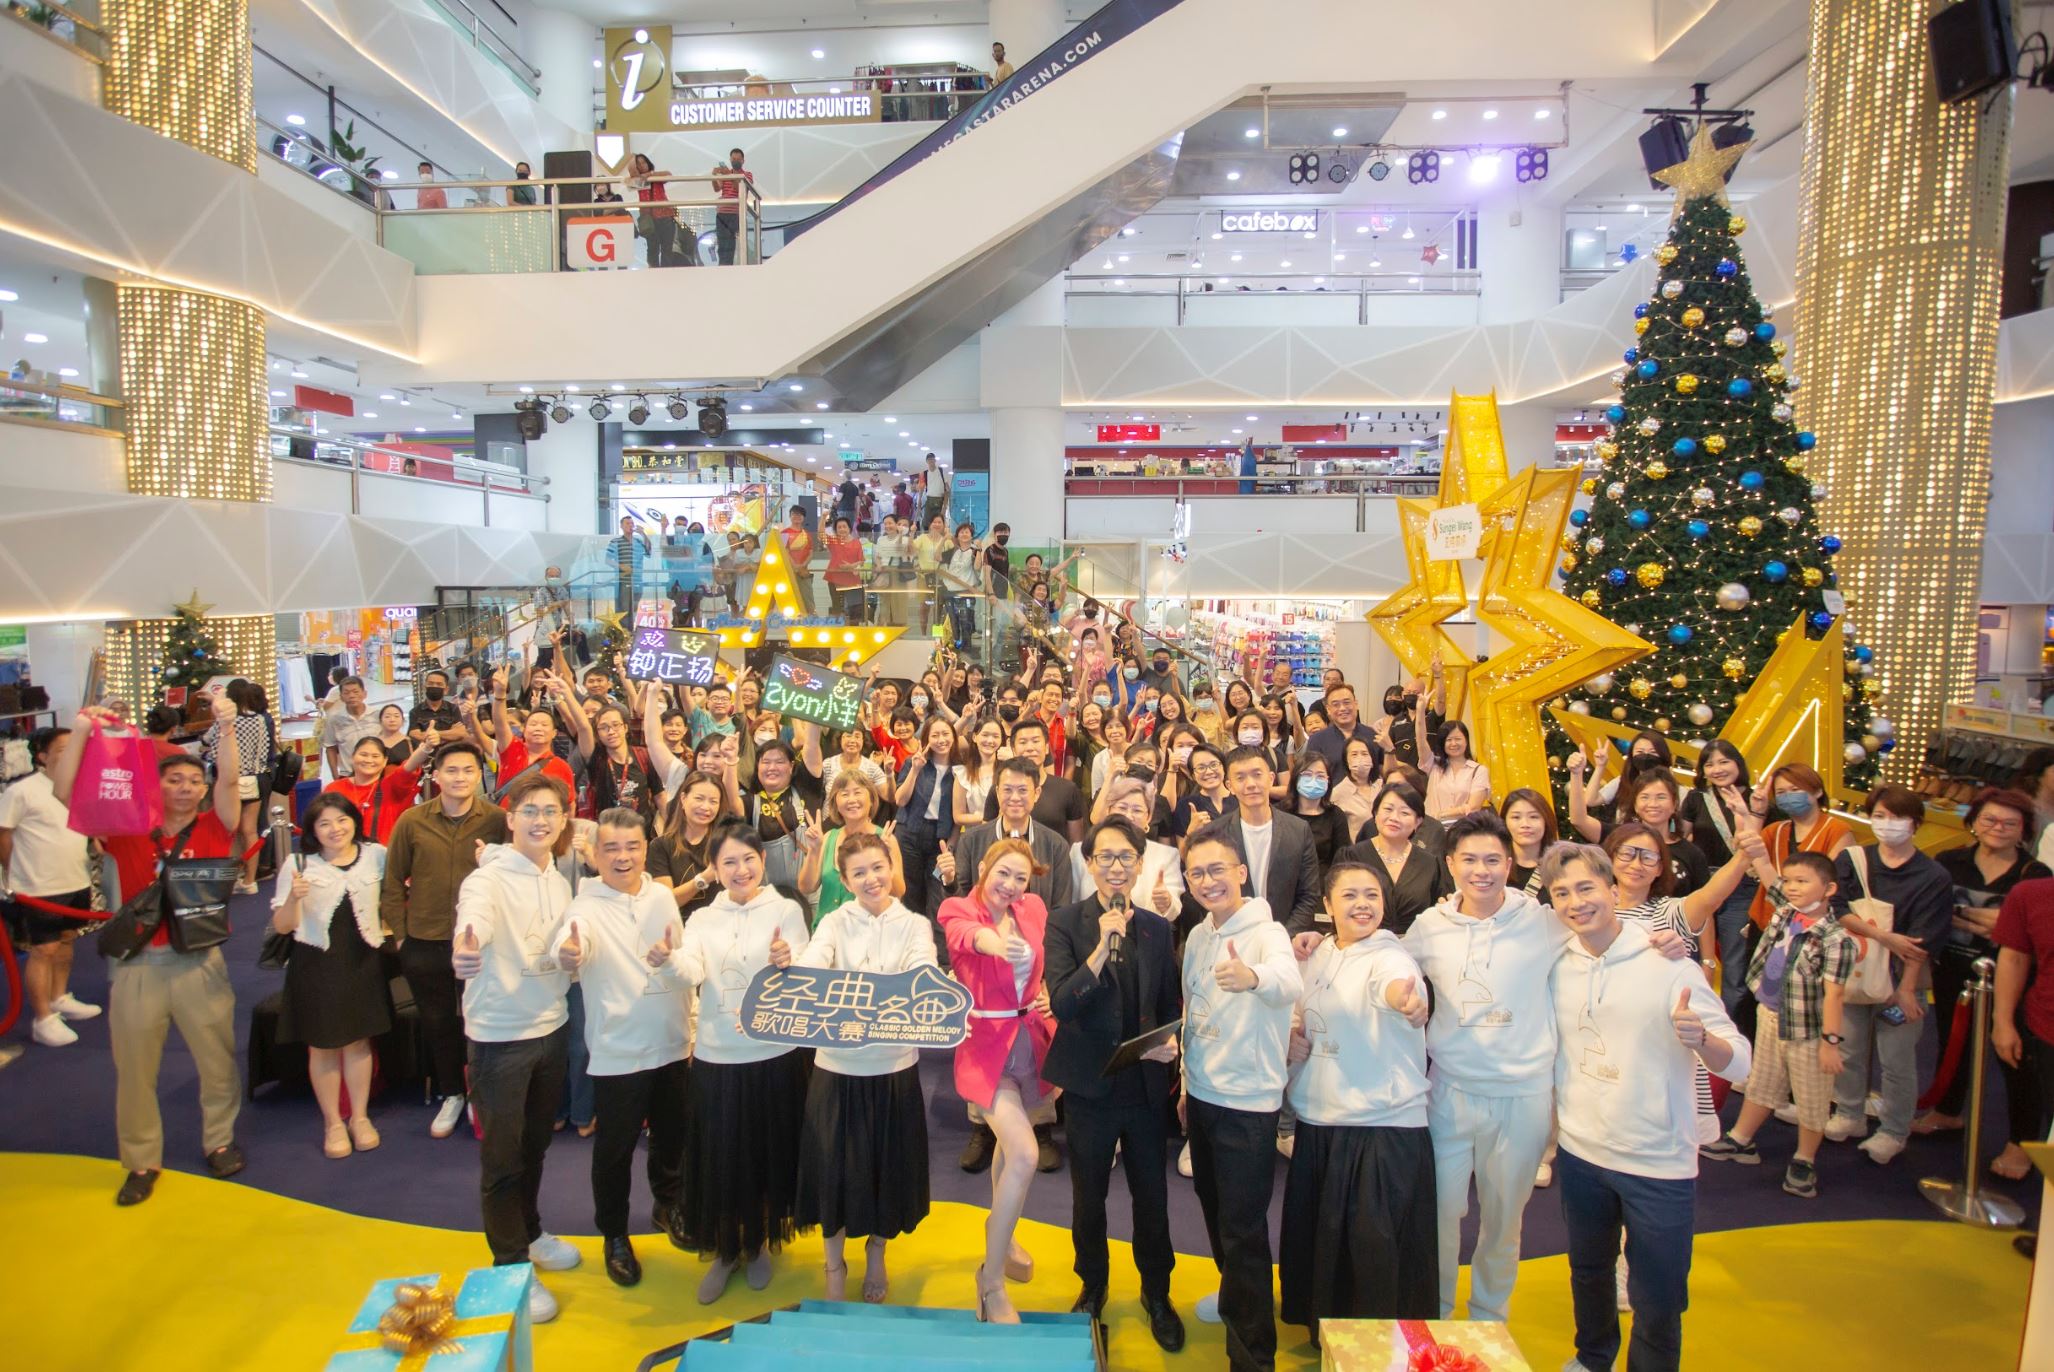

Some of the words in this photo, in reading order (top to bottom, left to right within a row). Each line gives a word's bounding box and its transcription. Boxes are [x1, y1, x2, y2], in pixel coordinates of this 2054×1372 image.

[671, 101, 745, 125] CUSTOMER
[746, 99, 805, 121] SERVICE
[807, 96, 872, 118] COUNTER
[1222, 211, 1316, 231] cafebox
[585, 228, 615, 263] G
[629, 648, 714, 684] 钟正扬
[101, 768, 134, 778] astro
[98, 790, 132, 800] HOUR
[751, 1011, 867, 1043] 歌唱大赛
[868, 1031, 898, 1040] SINGING
[898, 1032, 950, 1042] COMPETITION
[869, 1023, 901, 1032] CLASSIC
[901, 1024, 931, 1033] GOLDEN
[932, 1026, 962, 1035] MELODY
